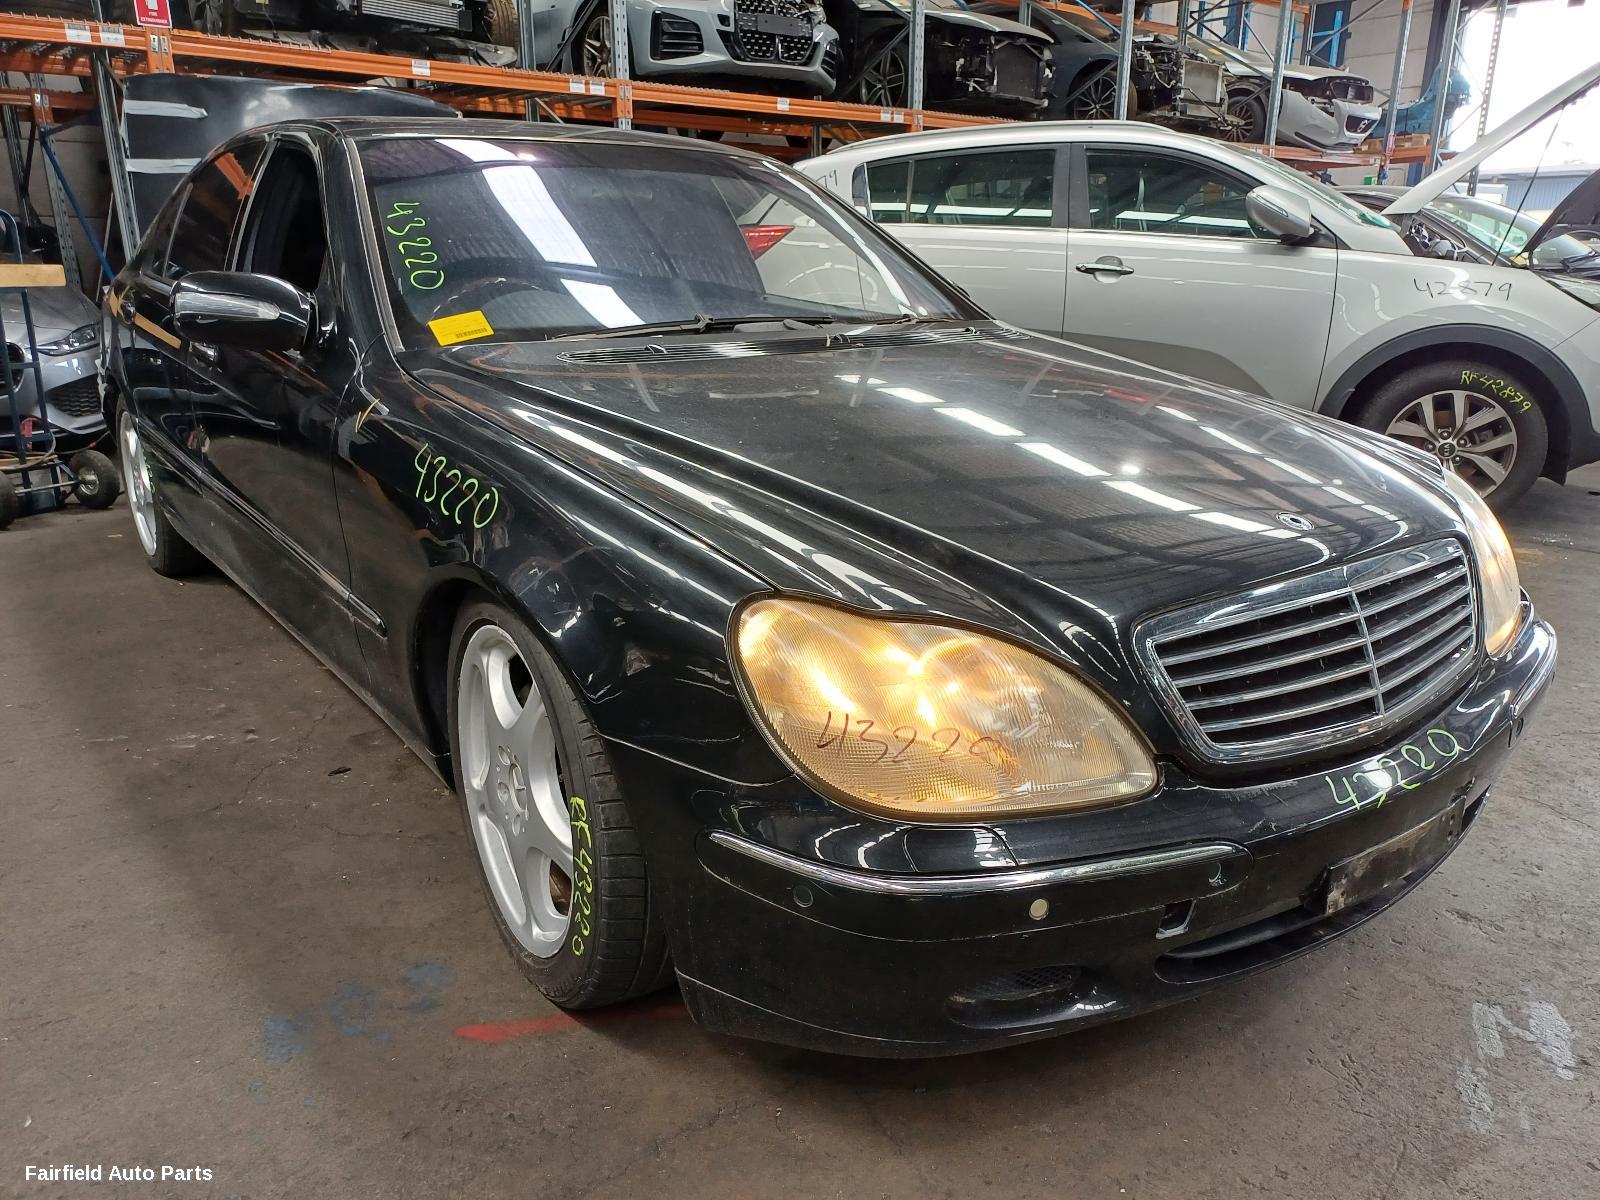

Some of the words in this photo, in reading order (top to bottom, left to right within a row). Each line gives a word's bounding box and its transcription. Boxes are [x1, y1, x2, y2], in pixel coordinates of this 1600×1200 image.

[387, 202, 445, 290] 43220
[1413, 278, 1512, 301] 42879
[414, 443, 499, 528] 43220
